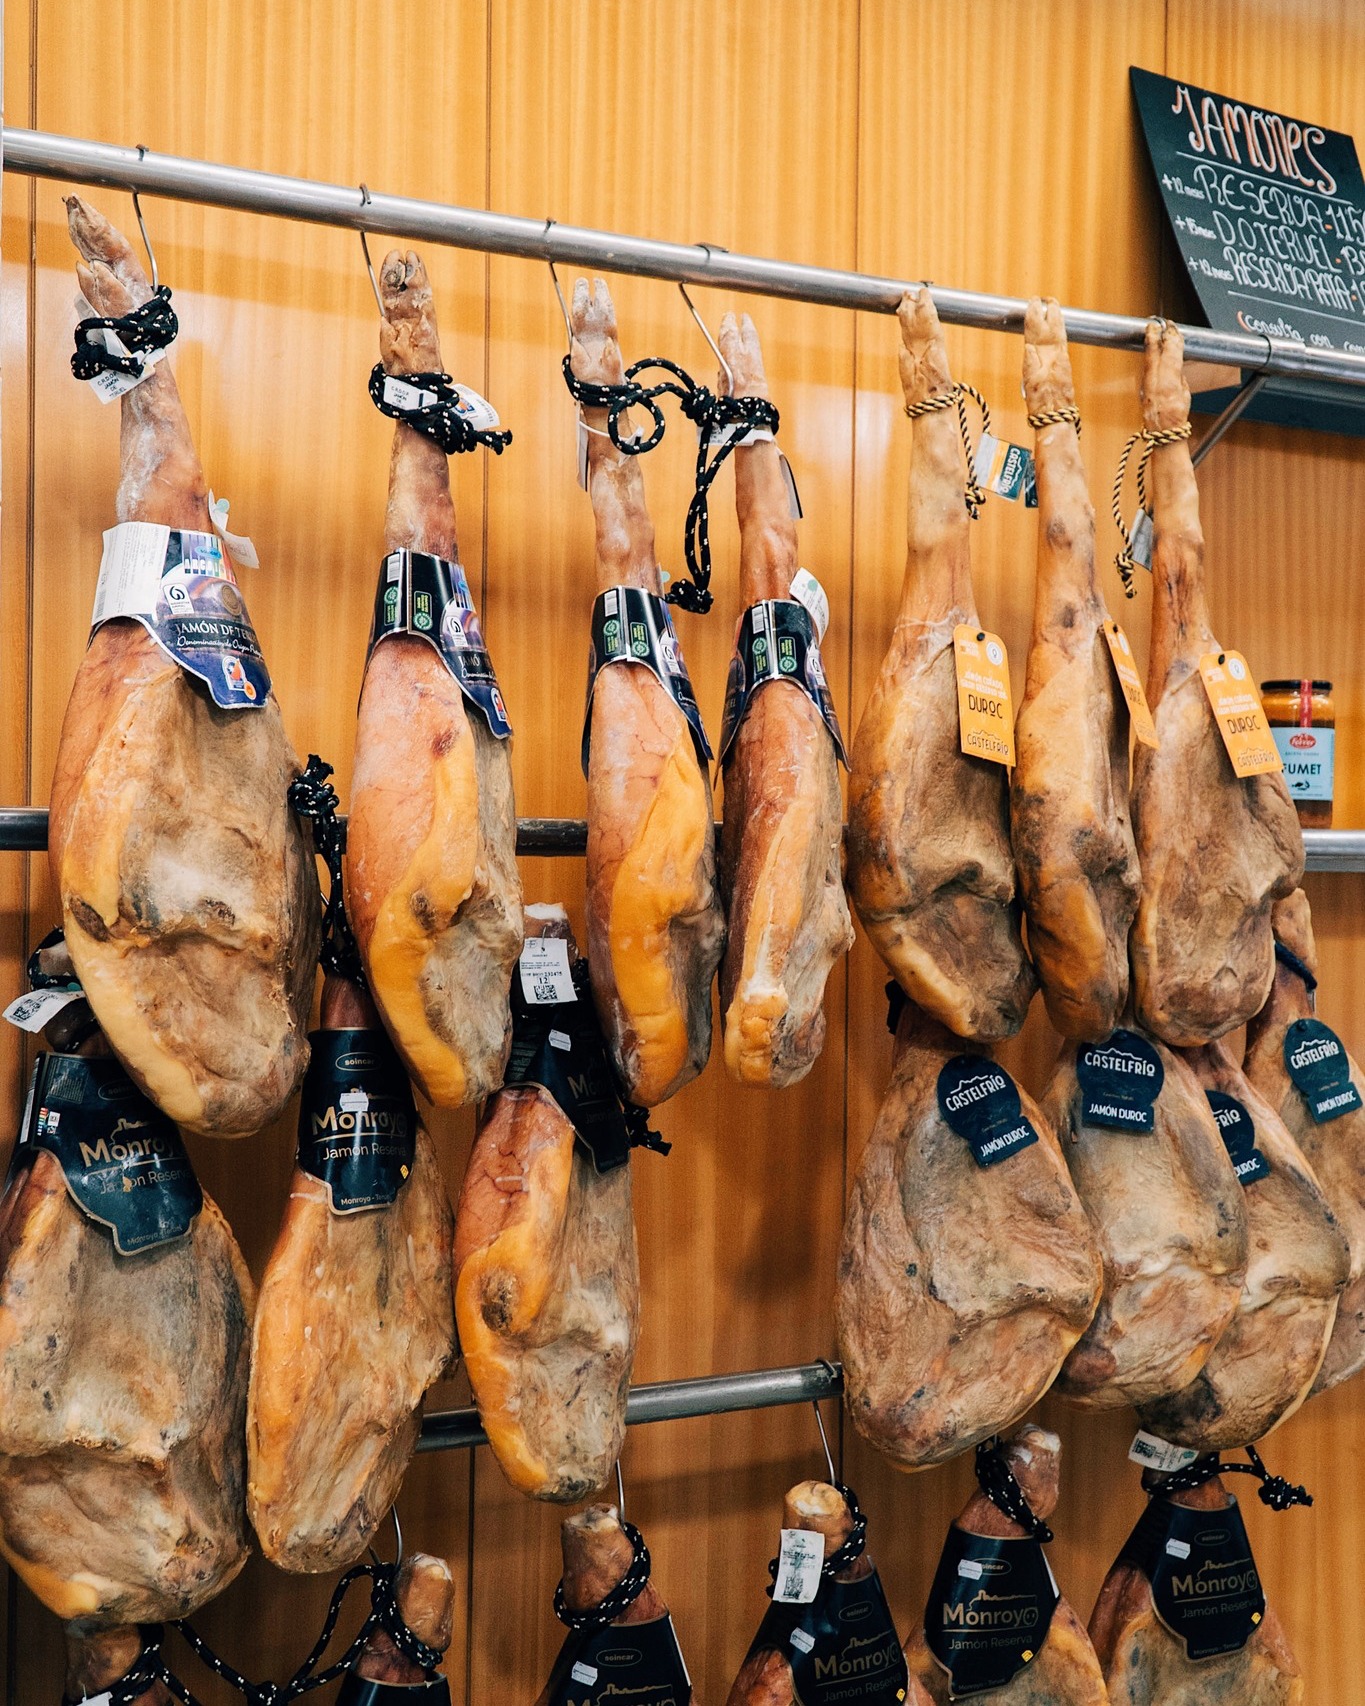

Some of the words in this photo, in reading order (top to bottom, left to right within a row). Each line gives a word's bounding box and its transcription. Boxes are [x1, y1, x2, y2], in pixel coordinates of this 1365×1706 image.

[1193, 164, 1327, 235] RESERVA
[175, 620, 219, 635] JAMÓN
[968, 694, 1003, 719] DUROC
[1227, 715, 1261, 734] DUROC
[1084, 1052, 1155, 1077] CASTELFRÍO
[945, 1074, 1007, 1112] CASTELFRÍO
[1088, 1103, 1118, 1118] JAMÓN
[1118, 1108, 1147, 1123] DUROC
[79, 1137, 179, 1168] Monroy
[980, 1137, 1006, 1157] JAMÓN
[1002, 1125, 1030, 1146] DUROC
[943, 1602, 1039, 1628] Monroyo
[1181, 1605, 1218, 1619] Jamón
[949, 1638, 988, 1650] Jamón
[991, 1634, 1033, 1649] Reserva
